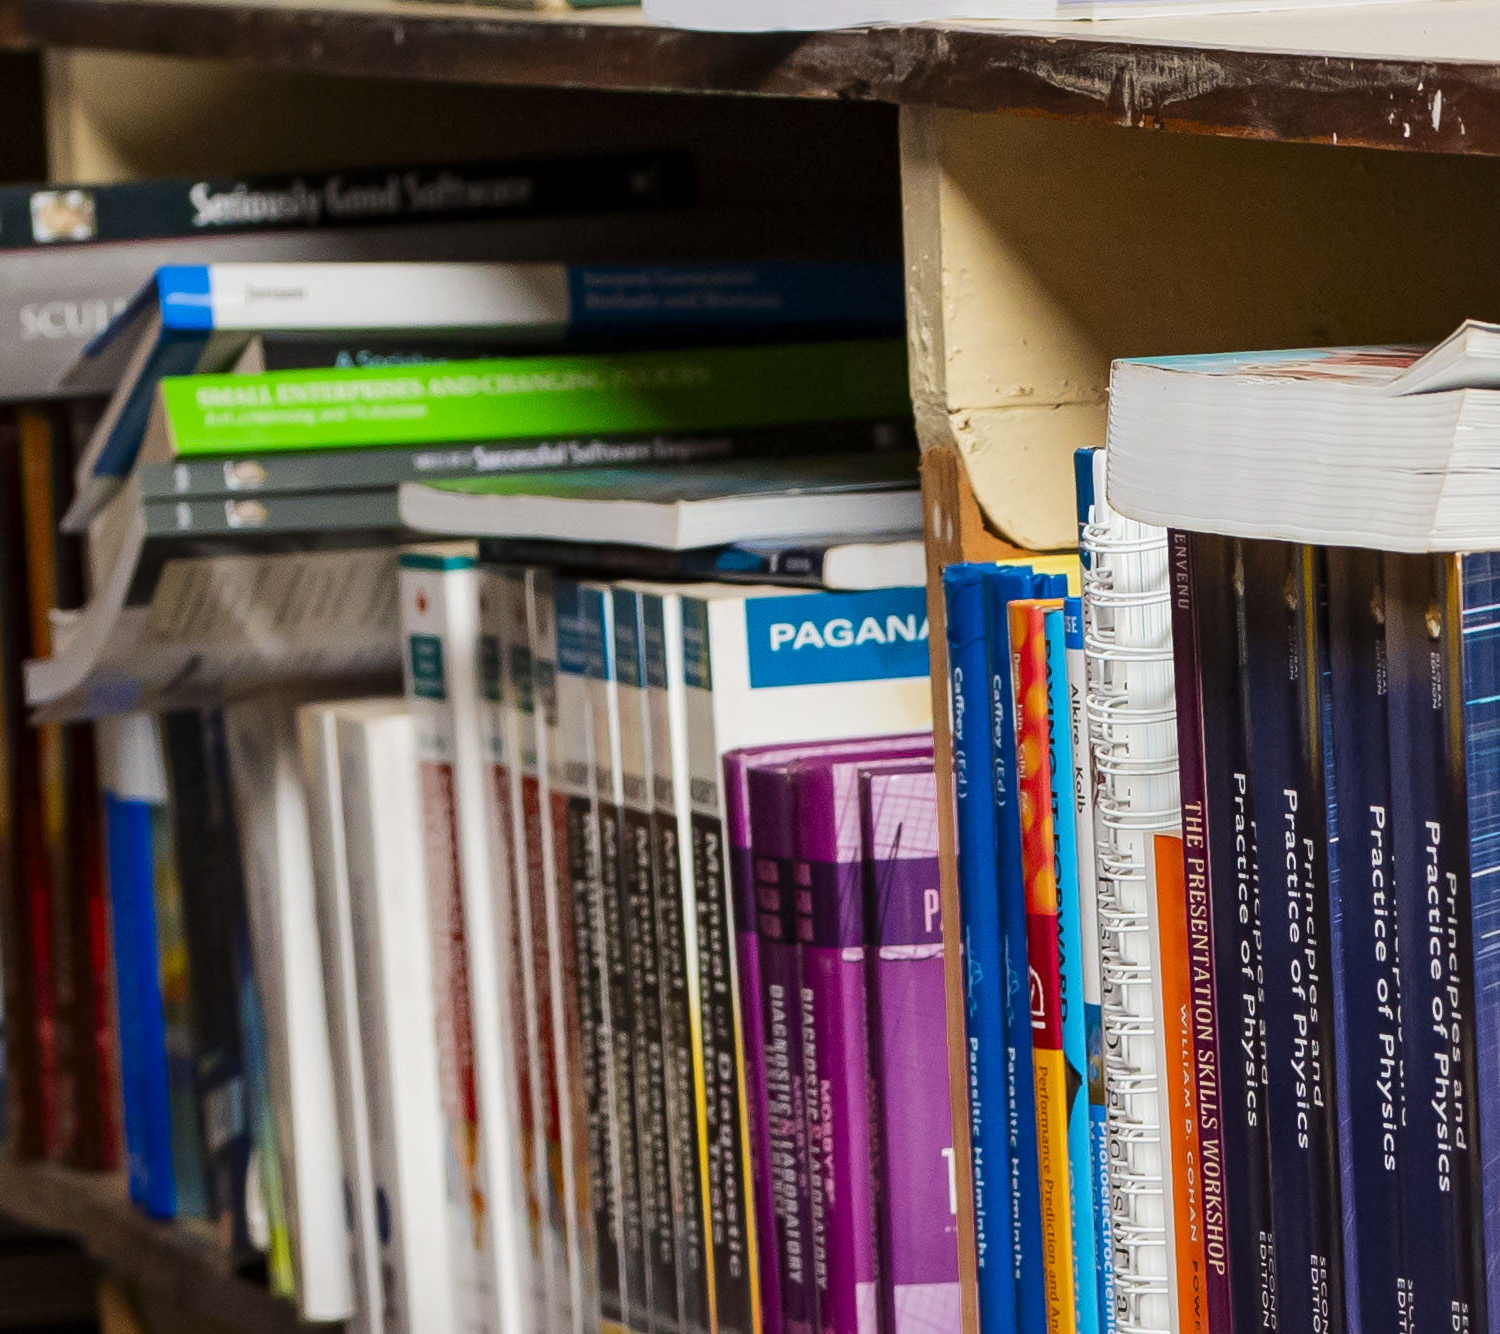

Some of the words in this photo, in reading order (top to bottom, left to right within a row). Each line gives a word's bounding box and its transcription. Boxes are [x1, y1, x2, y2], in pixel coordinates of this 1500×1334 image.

[953, 668, 966, 741] Caffrey
[990, 674, 1006, 748] Caffrey
[1070, 684, 1084, 745] Alkire
[1074, 765, 1086, 814] Kolb
[1184, 801, 1204, 849] THE
[1233, 772, 1250, 924] Practice
[1283, 788, 1302, 942] Practice
[1369, 805, 1391, 963] Practice
[1425, 820, 1446, 980] Practice
[1187, 857, 1214, 1042] PRESENTATION
[1240, 941, 1254, 979] of
[1290, 960, 1306, 998] of
[1303, 838, 1319, 1023] Principles
[1313, 1049, 1325, 1107] and
[1377, 978, 1395, 1018] of
[1446, 872, 1462, 1062] Principles
[1241, 993, 1260, 1127] Physics
[1432, 997, 1449, 1037] of
[1196, 1048, 1219, 1131] SKILLS
[1291, 1012, 1312, 1149] Physics
[1372, 1033, 1397, 1171] Physics
[1430, 1051, 1453, 1193] Physics
[1453, 1079, 1466, 1150] and
[974, 1147, 987, 1268] Helminths
[1011, 1158, 1023, 1280] Helminths
[1043, 1179, 1058, 1265] Prediction
[1187, 1150, 1197, 1242] COHAN
[1202, 1139, 1225, 1277] WORKSHOP
[1259, 1231, 1270, 1328] EDITION
